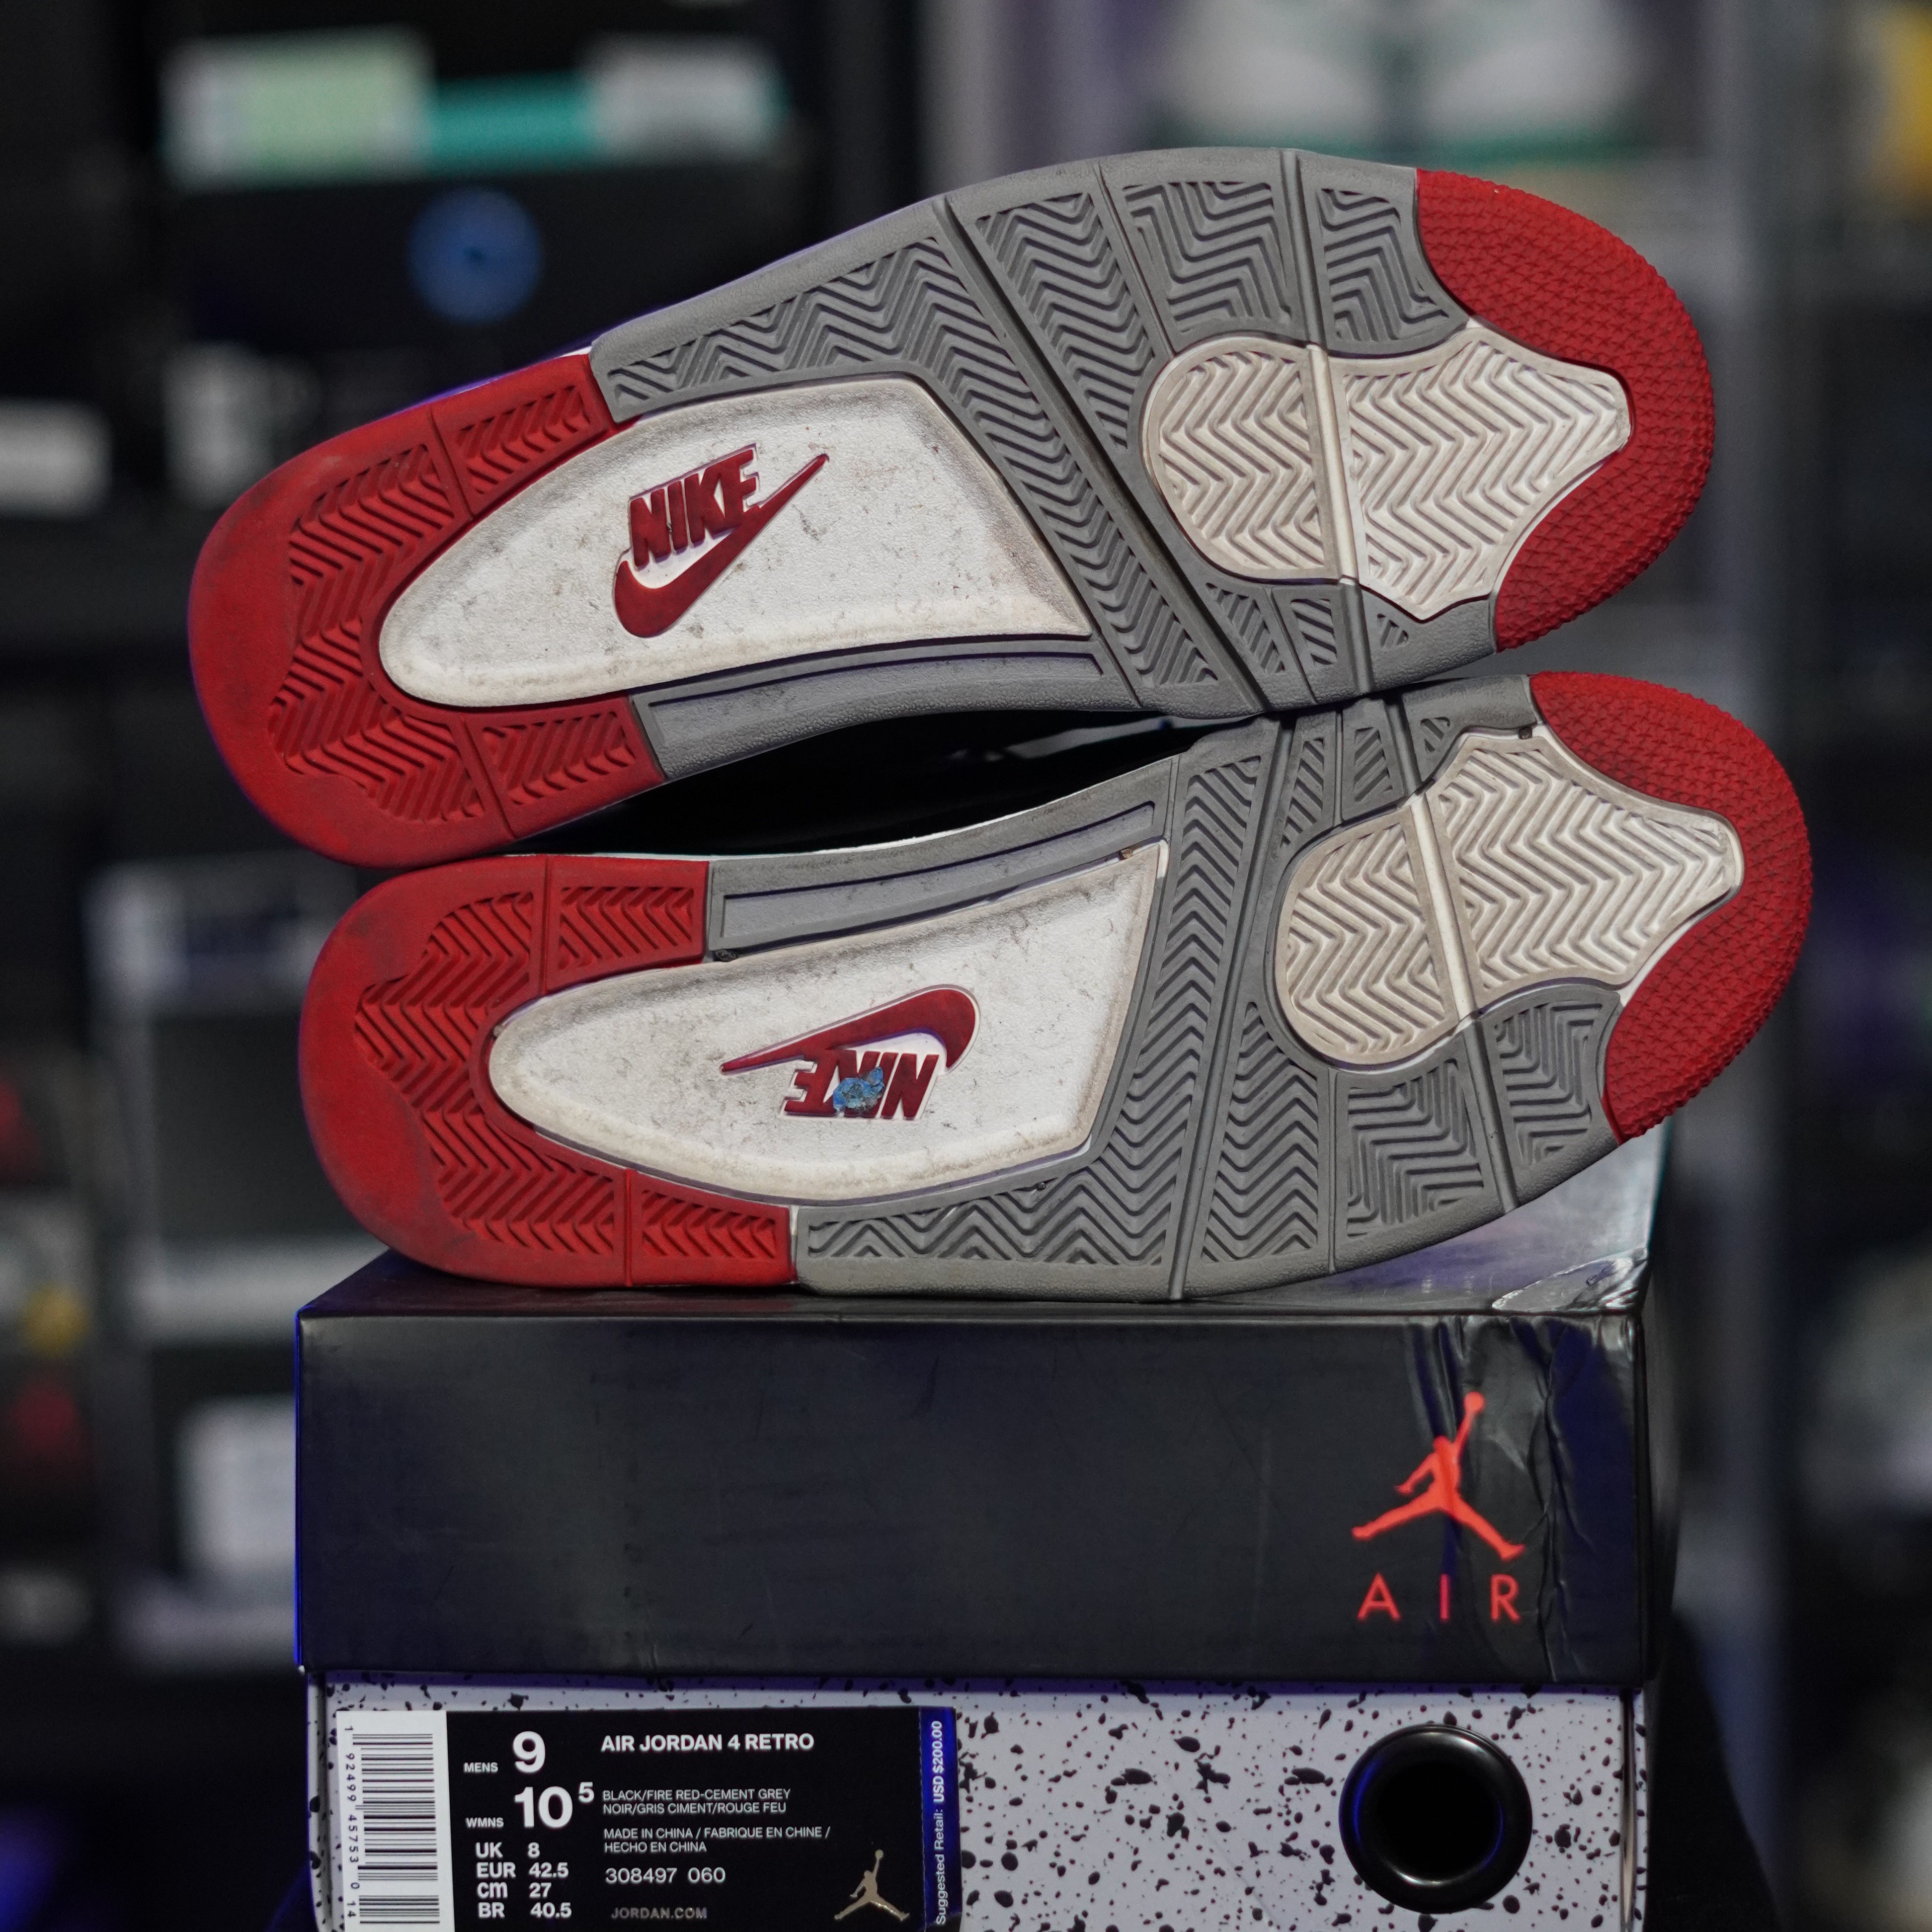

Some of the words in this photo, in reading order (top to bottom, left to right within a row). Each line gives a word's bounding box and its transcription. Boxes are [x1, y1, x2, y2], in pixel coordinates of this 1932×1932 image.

[629, 448, 760, 572] NIKE
[1357, 1572, 1522, 1622] AIR
[601, 1735, 635, 1752] AIR
[639, 1734, 722, 1752] JORDAN
[728, 1734, 741, 1750] 4
[745, 1733, 815, 1750] RETRO
[931, 1721, 944, 1774] $200.00
[463, 1762, 499, 1773] MENS
[512, 1731, 546, 1774] 9
[603, 1789, 673, 1802] BLACK/FIRE
[676, 1789, 755, 1800] RED-CEMENT
[758, 1788, 791, 1800] GREY
[932, 1775, 945, 1803] USD
[603, 1803, 665, 1815] NOIR/GRIS
[668, 1802, 760, 1814] CIMENT/ROUGE
[763, 1802, 786, 1813] FEU
[465, 1817, 504, 1828] WMNS
[933, 1809, 944, 1850] Retail:
[604, 1828, 638, 1839] MADE
[641, 1828, 653, 1839] IN
[656, 1827, 693, 1839] CHINA
[704, 1827, 763, 1838] FABRIQUE
[766, 1827, 782, 1838] EN
[785, 1826, 822, 1838] CHINE
[475, 1842, 503, 1859] UK
[527, 1842, 540, 1859] 8
[604, 1841, 648, 1853] HECHO
[650, 1841, 667, 1853] EN
[669, 1841, 707, 1853] CHINA
[476, 1862, 516, 1879] EUR
[528, 1862, 569, 1878] 42.5
[606, 1867, 677, 1884] 308497
[688, 1867, 726, 1884] 060
[477, 1882, 508, 1899] cm
[529, 1882, 552, 1898] 27
[935, 1854, 947, 1925] Suggested
[478, 1902, 505, 1918] BR
[530, 1902, 572, 1918] 40.5
[611, 1907, 707, 1919] JORDAN.COM
